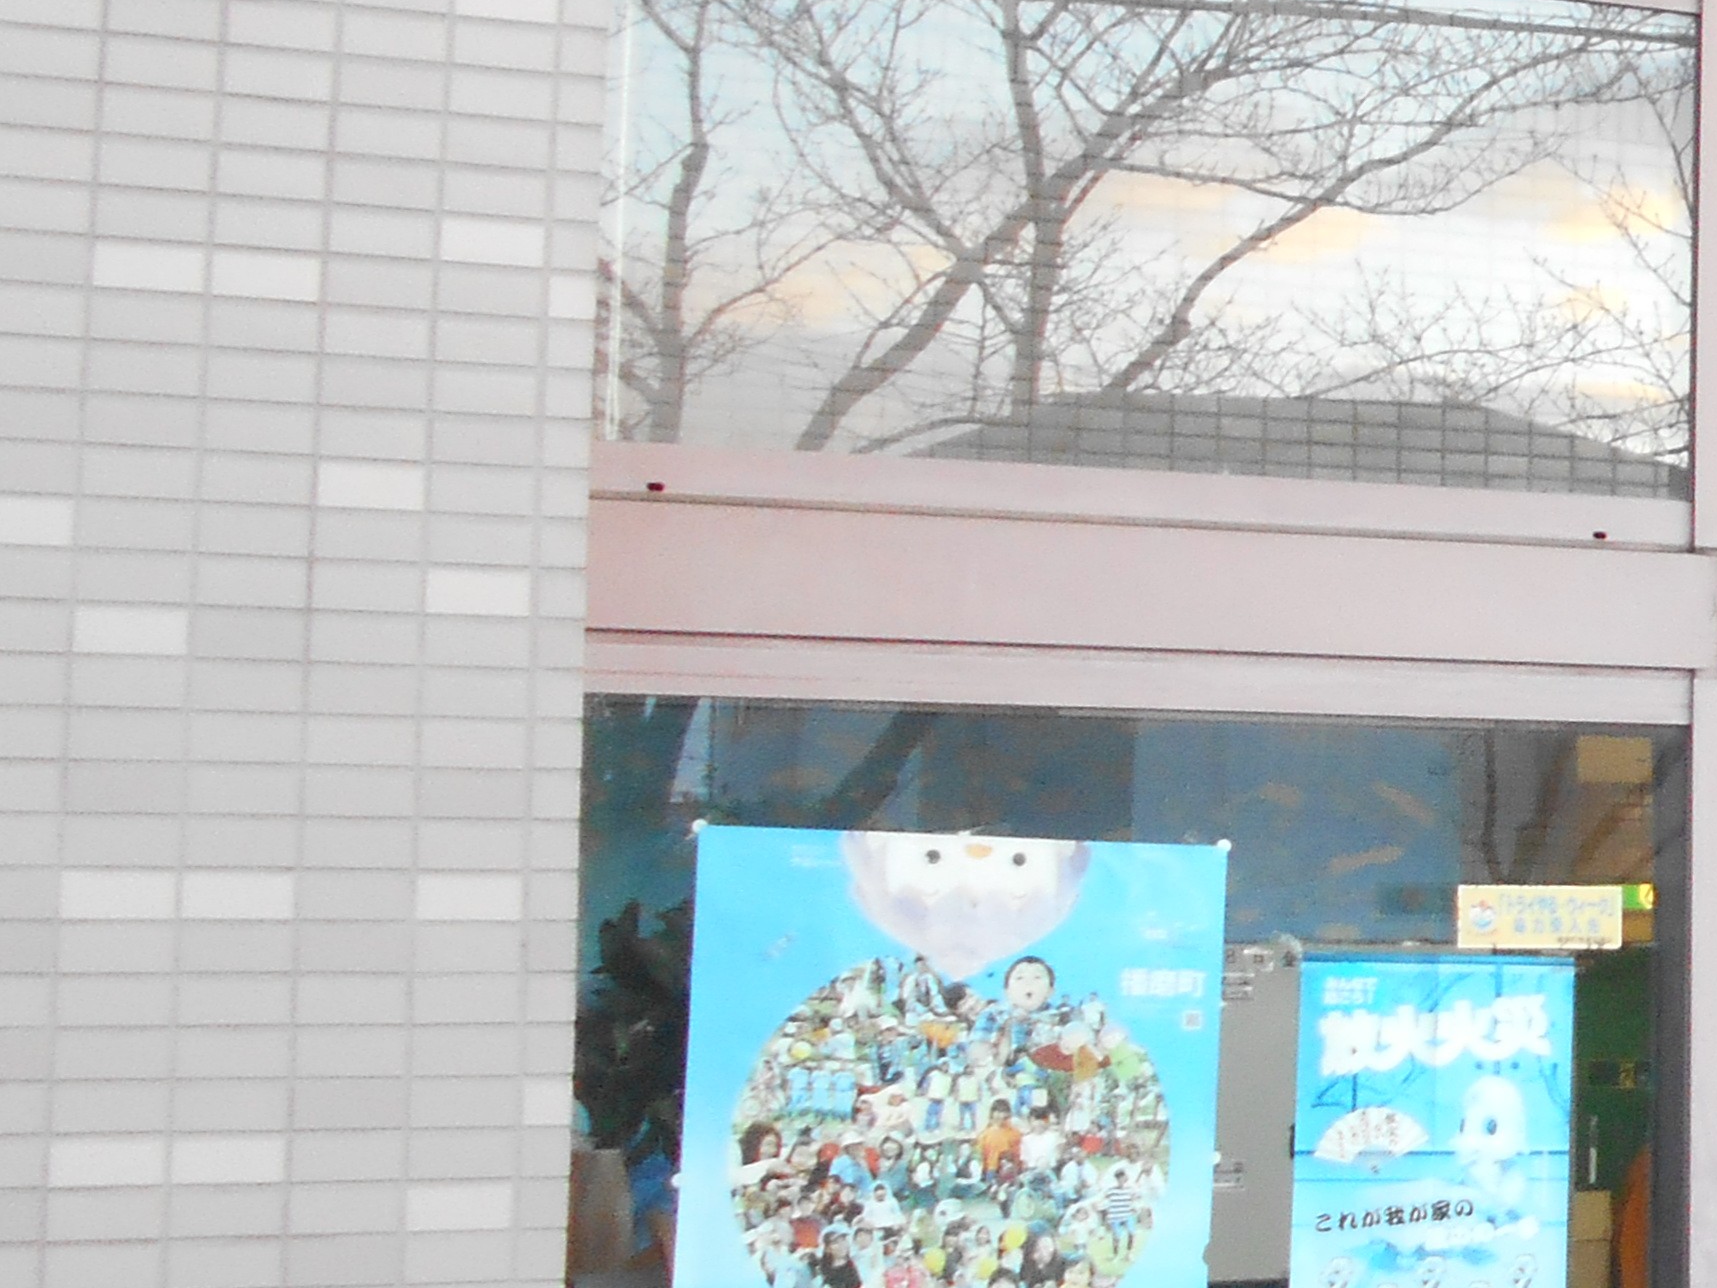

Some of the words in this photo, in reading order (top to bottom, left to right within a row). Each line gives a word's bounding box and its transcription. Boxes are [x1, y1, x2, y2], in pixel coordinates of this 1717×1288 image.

[1315, 1199, 1474, 1233] これが我が家の
